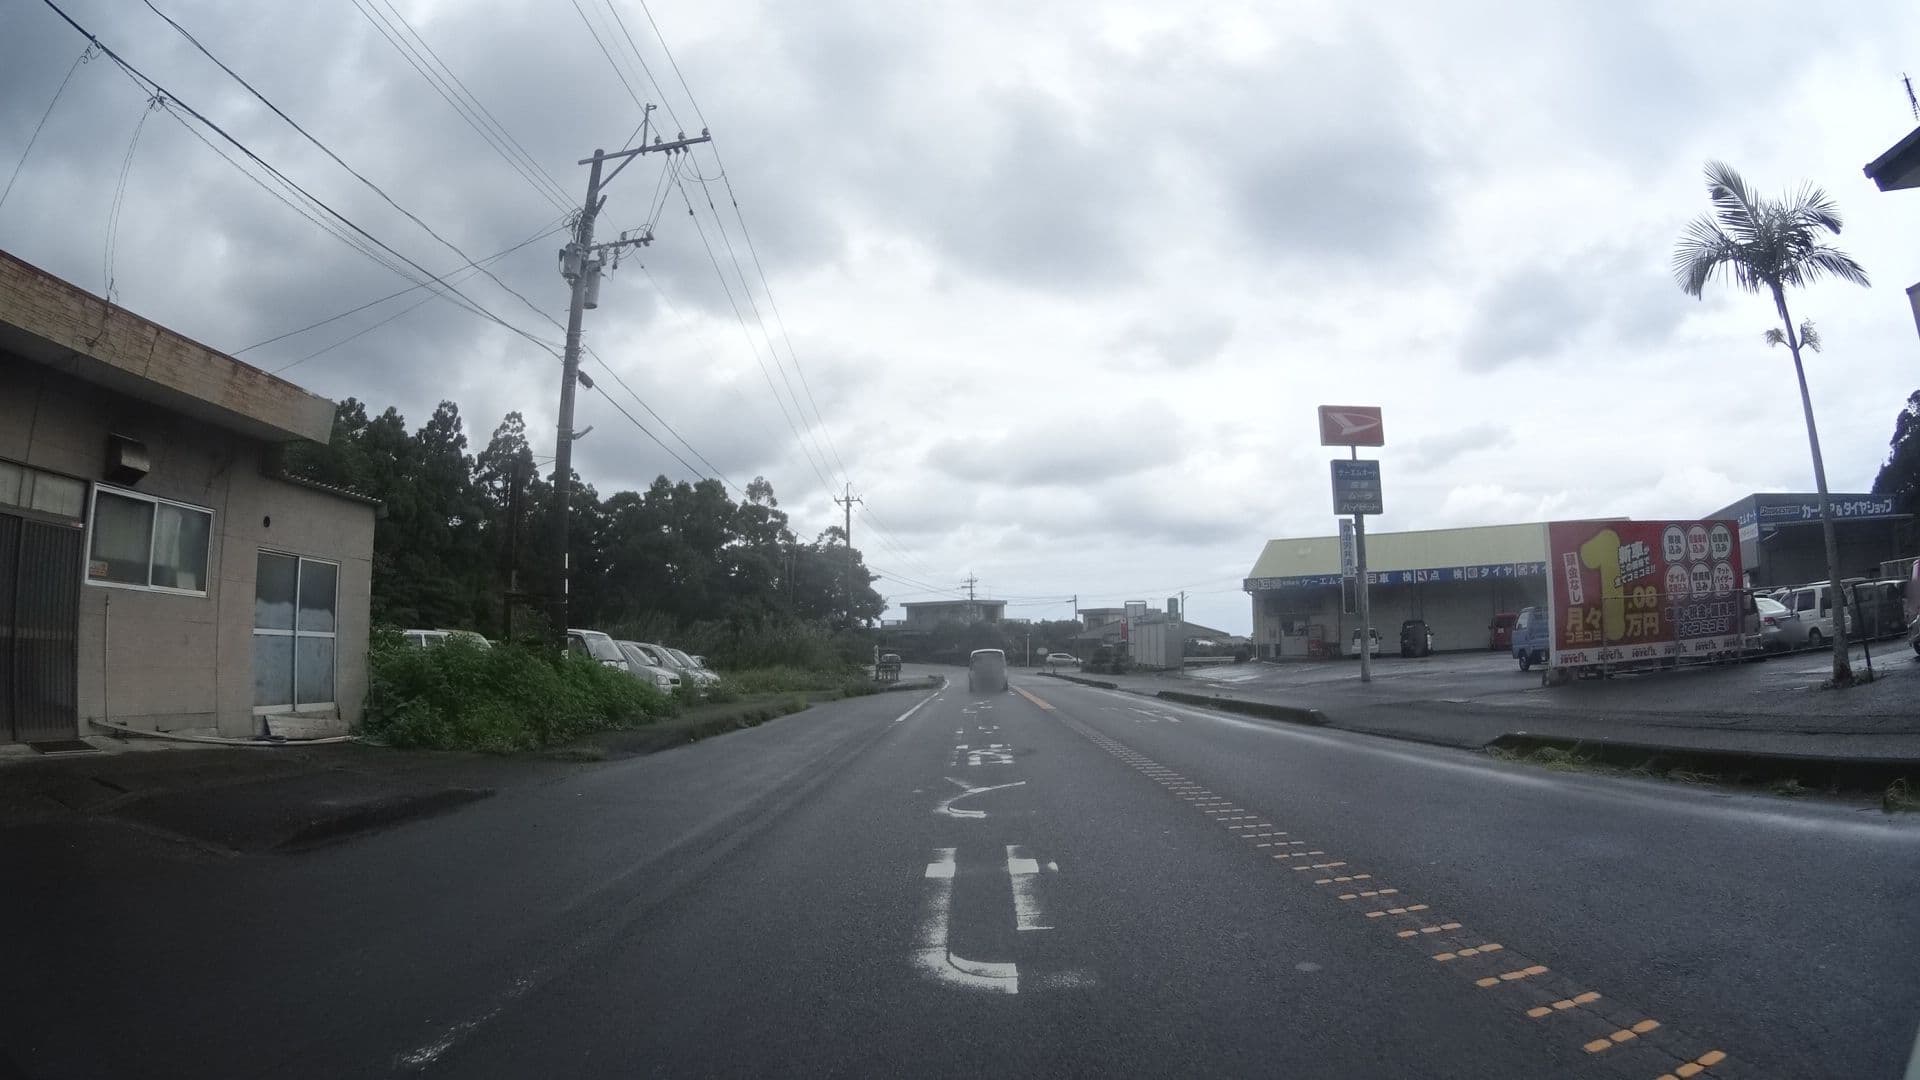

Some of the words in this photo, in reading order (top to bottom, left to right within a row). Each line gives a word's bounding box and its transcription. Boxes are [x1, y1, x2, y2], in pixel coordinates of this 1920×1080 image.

[1480, 565, 1513, 578] タイヤ
[1580, 528, 1626, 641] 1
[1567, 608, 1602, 632] 月々
[1625, 612, 1660, 637] 万円
[1566, 632, 1602, 644] コミコミ
